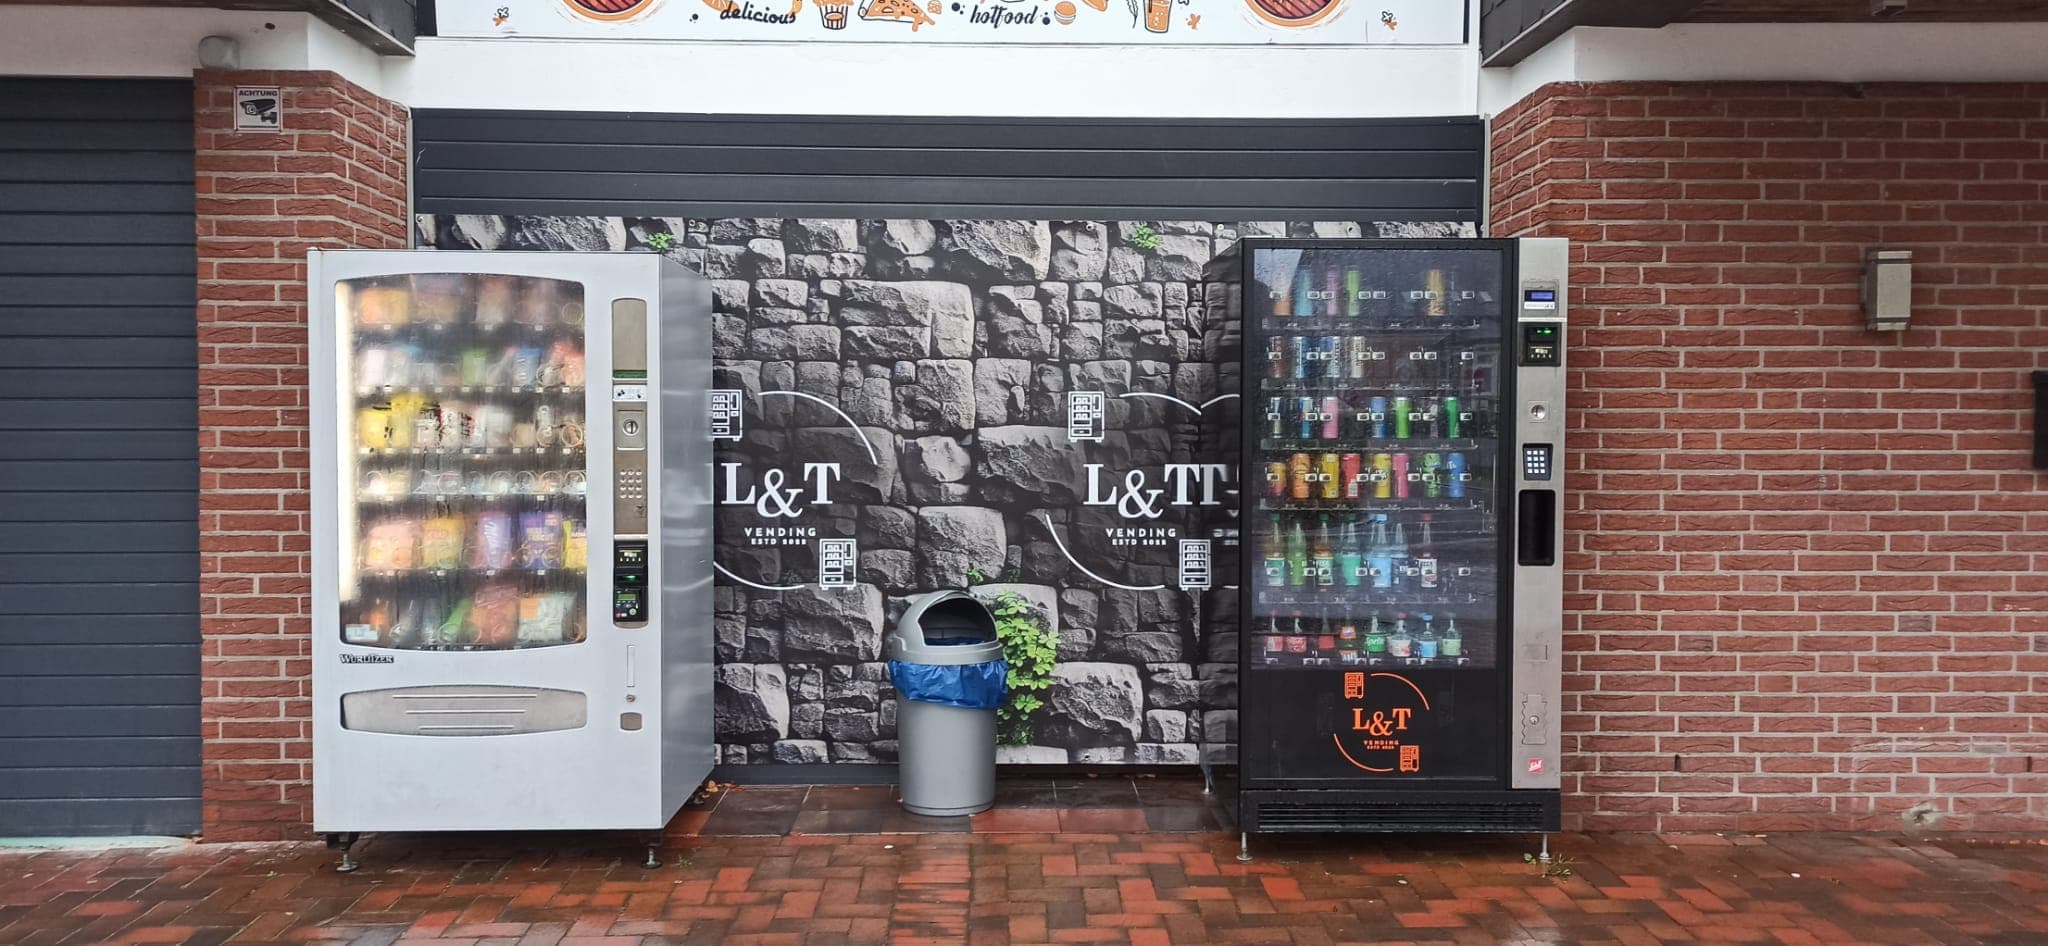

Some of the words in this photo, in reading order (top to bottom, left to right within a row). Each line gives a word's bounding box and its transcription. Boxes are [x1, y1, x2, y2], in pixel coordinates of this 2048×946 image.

[720, 0, 796, 24] delicious
[721, 462, 841, 518] L&T
[1083, 463, 1200, 519] L&T
[744, 527, 817, 537] VENDING
[1105, 528, 1177, 537] VENDING
[1352, 708, 1411, 736] L&T
